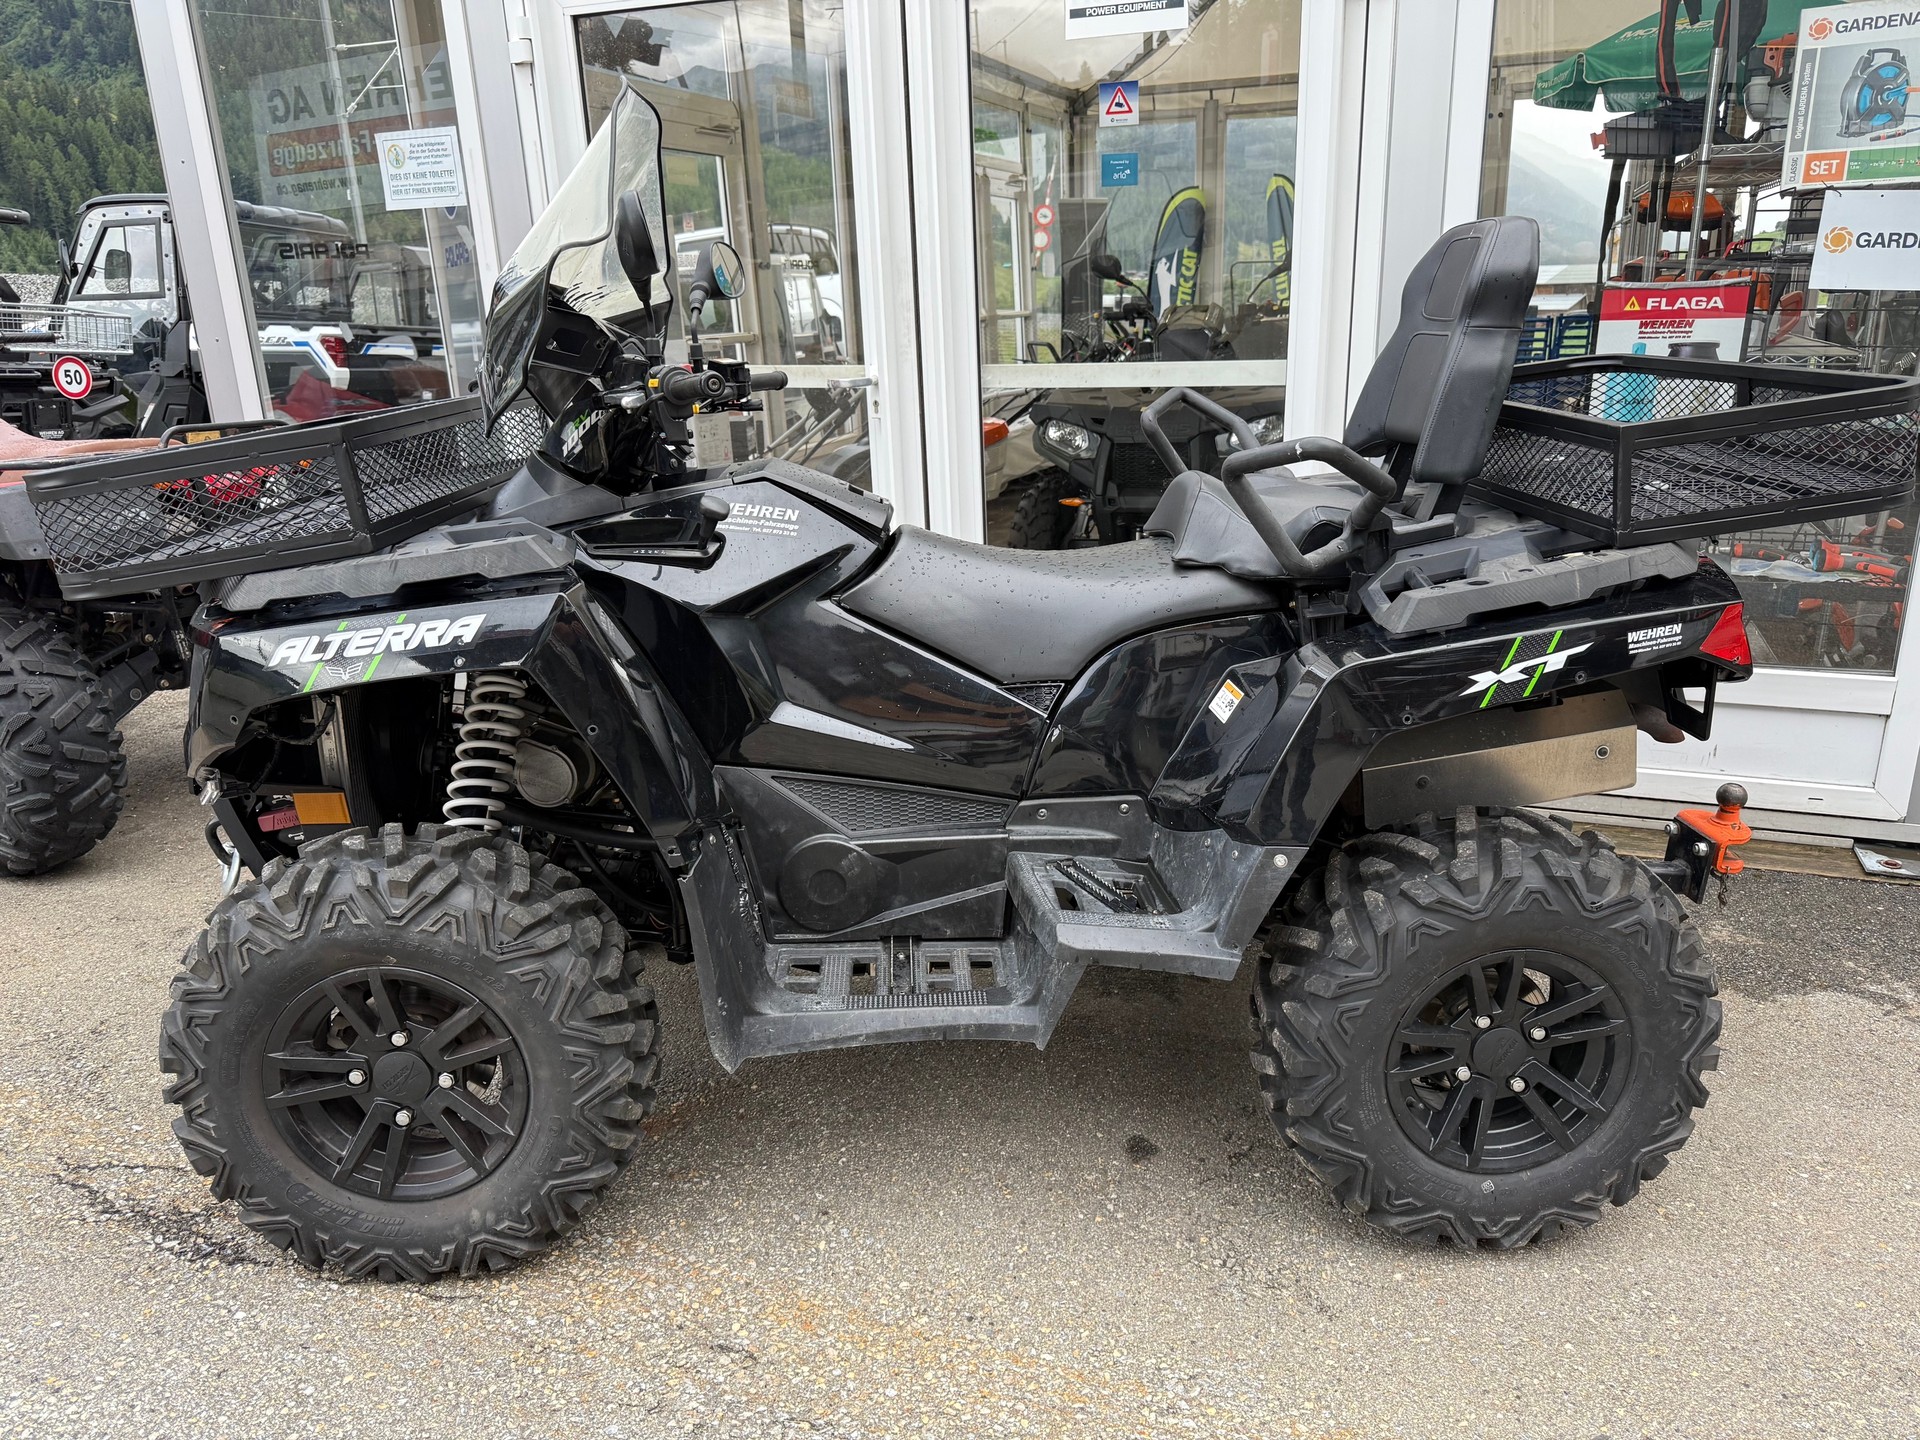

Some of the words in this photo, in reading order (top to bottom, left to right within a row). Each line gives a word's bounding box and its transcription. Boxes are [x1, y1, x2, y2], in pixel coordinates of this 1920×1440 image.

[1086, 4, 1116, 17] POWER
[1118, 1, 1167, 14] EQUIPMENT
[1835, 12, 1920, 34] GARDENA
[1802, 63, 1812, 85] System
[1797, 86, 1808, 115] GARDENA
[1795, 116, 1805, 139] Original
[390, 173, 402, 181] DIES
[403, 172, 411, 180] IST
[413, 171, 427, 179] KEINE
[429, 170, 454, 178] TOILETTE!
[1113, 171, 1126, 180] arlo
[1789, 157, 1798, 182] CLASSIC
[1809, 159, 1840, 176] SET
[1856, 232, 1920, 249] GARD
[1180, 246, 1197, 277] CAT
[1647, 297, 1724, 310] FLAGA
[1639, 320, 1695, 329] WEHREN
[64, 369, 82, 385] 50
[723, 517, 799, 530] schinen-Fahrzeuge
[268, 614, 487, 667] ALTERRA
[1628, 623, 1682, 643] WEHREN
[1458, 642, 1594, 697] XT
